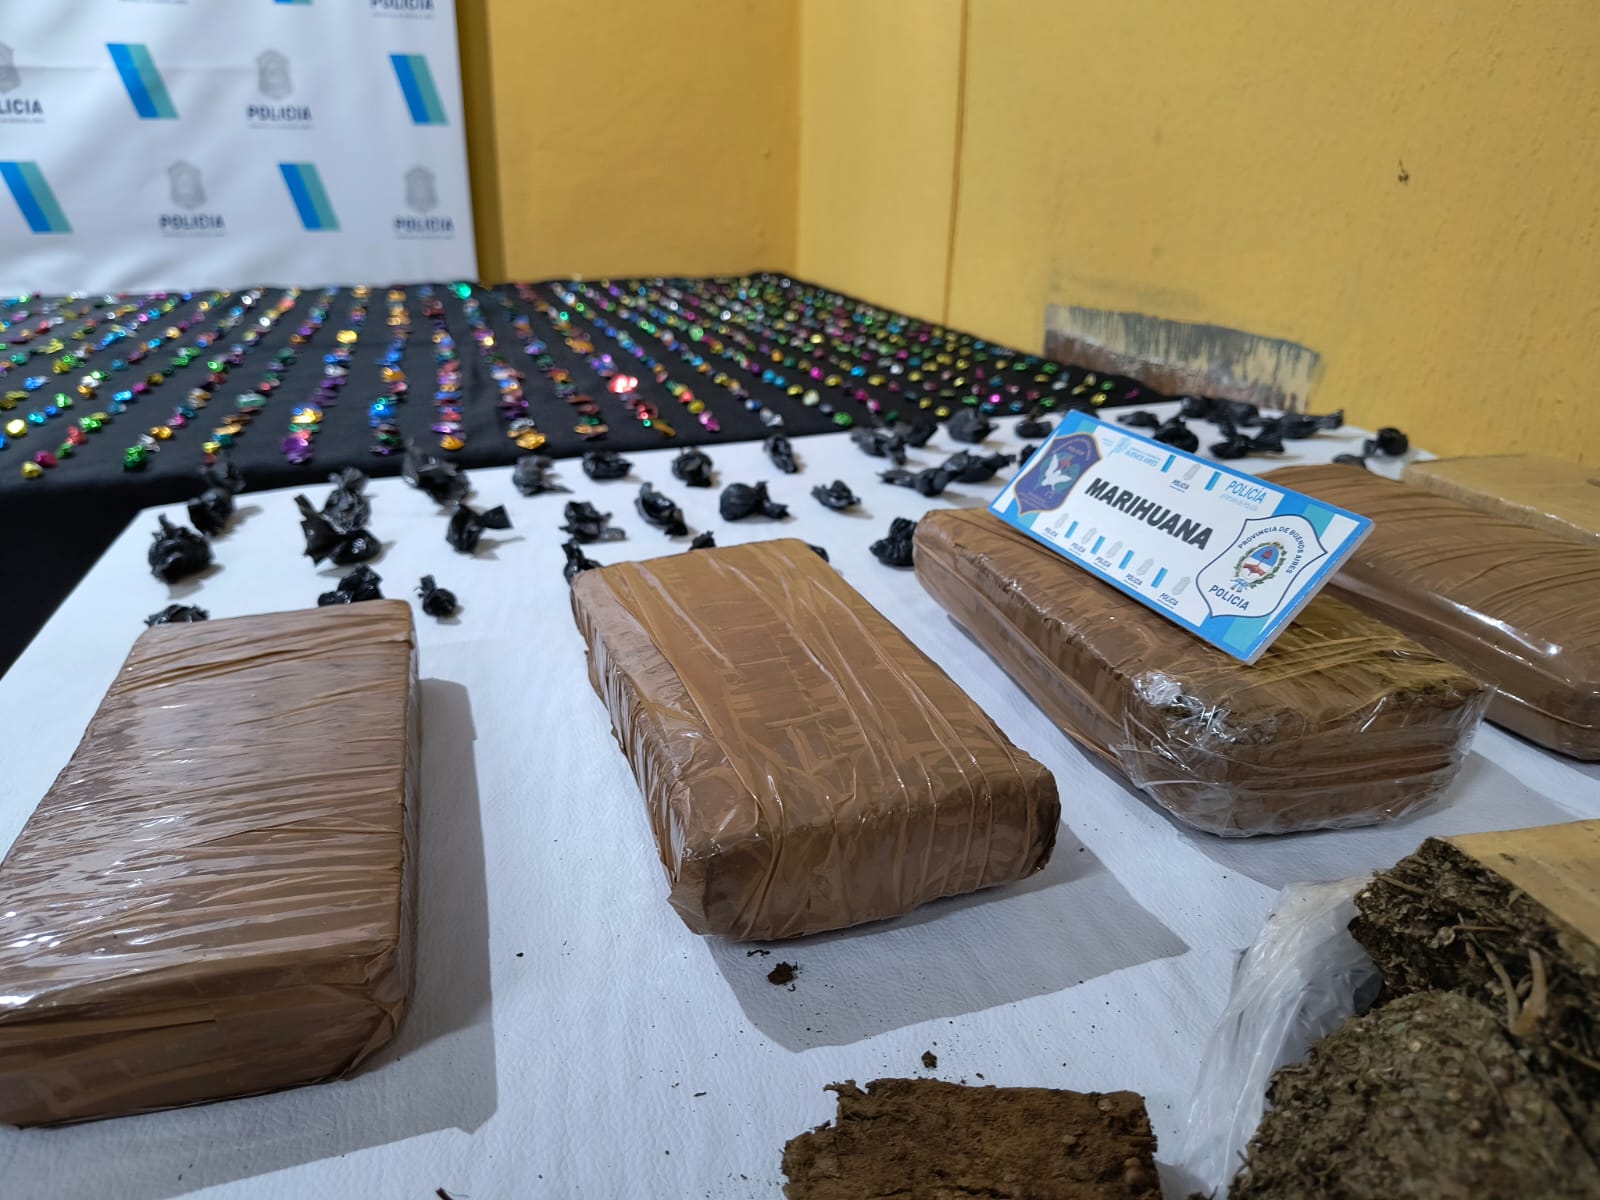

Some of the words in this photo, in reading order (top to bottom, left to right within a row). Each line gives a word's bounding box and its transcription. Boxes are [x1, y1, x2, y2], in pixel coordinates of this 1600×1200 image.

[0, 98, 44, 115] LICIA
[1084, 477, 1214, 551] MARIHUANA
[1238, 526, 1277, 549] PROVINCIA
[1278, 526, 1290, 534] DE
[1288, 529, 1305, 553] BUENOS
[1285, 554, 1303, 574] AIRES
